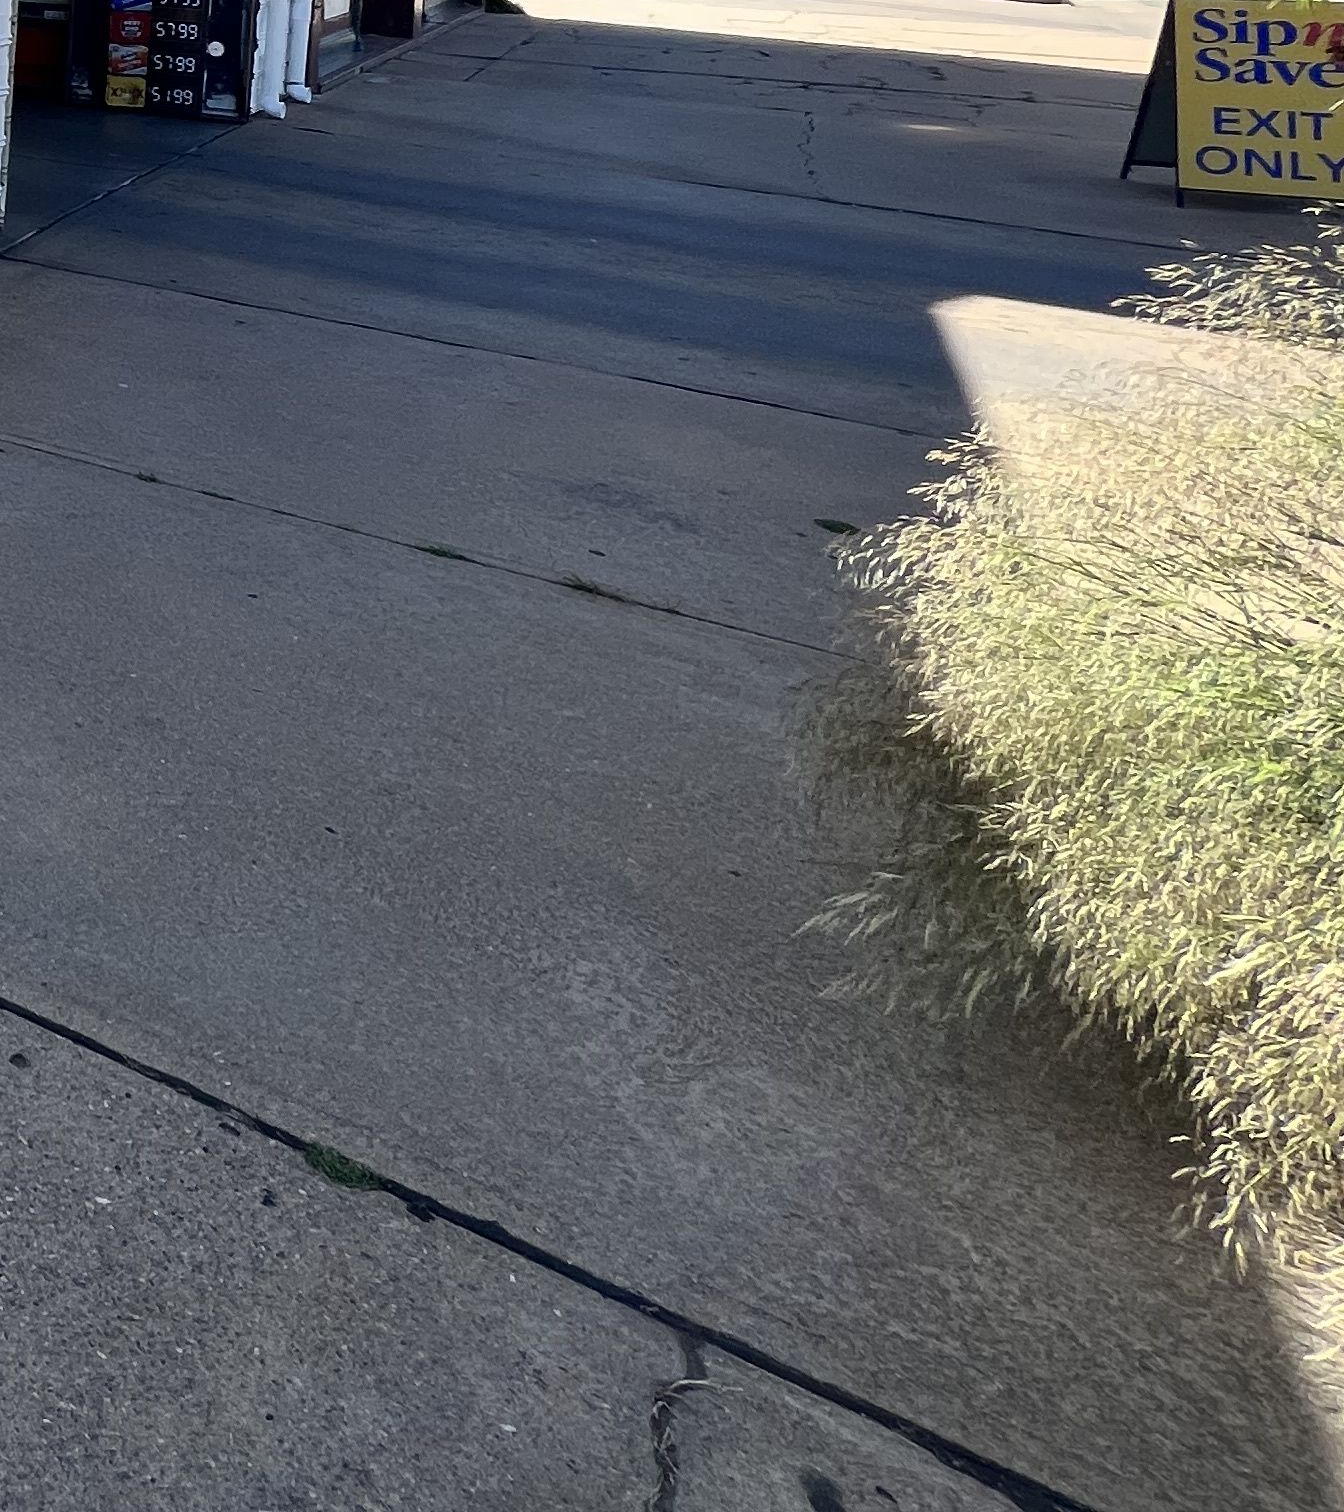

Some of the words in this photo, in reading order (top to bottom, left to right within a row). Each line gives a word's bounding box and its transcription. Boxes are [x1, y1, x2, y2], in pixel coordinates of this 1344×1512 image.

[1194, 47, 1344, 88] Save
[1213, 107, 1334, 141] EXIT
[1195, 145, 1344, 183] ONLY
